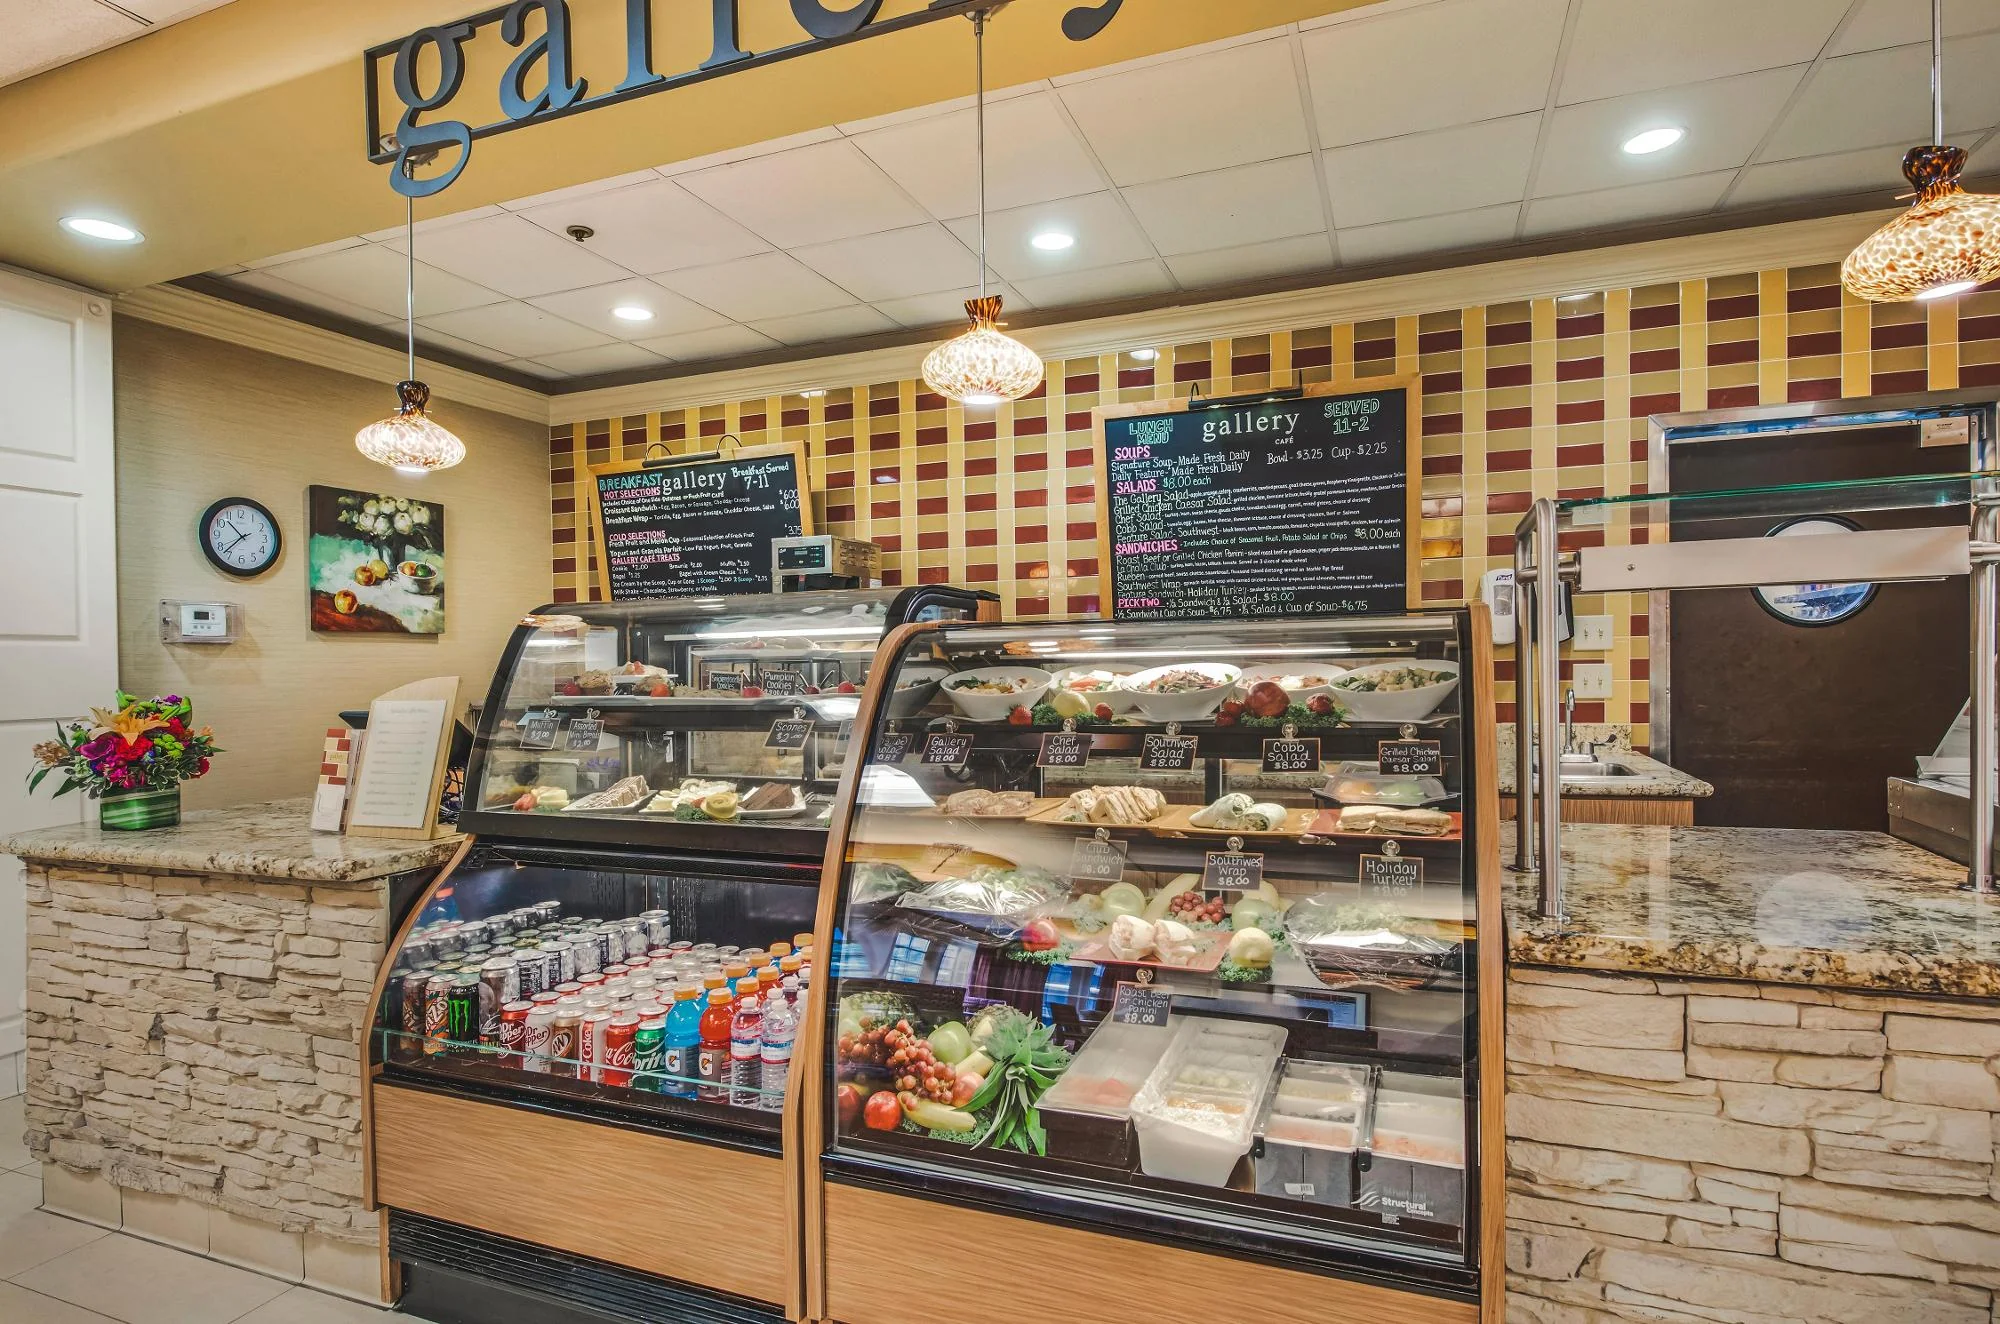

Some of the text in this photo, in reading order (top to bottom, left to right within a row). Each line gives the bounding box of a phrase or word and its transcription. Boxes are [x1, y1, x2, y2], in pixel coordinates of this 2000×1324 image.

[1324, 398, 1380, 418] SERVED
[1129, 418, 1174, 435] LUNCH
[1202, 411, 1300, 443] gallery
[1333, 416, 1370, 435] 11-2
[1137, 431, 1169, 446] MENU
[1275, 436, 1294, 445] CAFÉ
[1111, 441, 1388, 473] Signature Fresh Daily $3.25 $2.25
[1114, 445, 1151, 461] SOUPS
[731, 462, 789, 477] Breakfast Served
[1112, 461, 1244, 482] Daily Made Fresh Daily
[599, 473, 663, 491] BREAKFAST
[662, 470, 726, 495] gallery
[743, 473, 769, 490] 7-11
[1163, 475, 1212, 489] $8.00 each
[604, 487, 661, 500] HOT SELECTIONS
[1113, 492, 1163, 508] The Gallery
[603, 504, 658, 515] Croissant Sandwich
[1113, 503, 1139, 517] Grilled
[1142, 499, 1173, 513] Chicken
[1174, 498, 1205, 510] Caesar
[225, 511, 232, 521] 11
[237, 509, 245, 519] 12
[605, 516, 633, 524] Breakfast
[1115, 513, 1136, 525] Chef
[216, 518, 226, 529] 10
[258, 522, 265, 533] 2
[213, 529, 221, 540] 9
[610, 529, 667, 543] COLD SELECTIONS
[1115, 524, 1138, 536] Cobb
[262, 534, 268, 544] 3
[1115, 540, 1178, 556] SANDWICHES
[1211, 538, 1229, 547] Choice
[1230, 536, 1237, 545] of
[1303, 531, 1320, 542] Salad
[1354, 527, 1384, 541] $8.00
[1386, 525, 1401, 539] each
[217, 542, 224, 552] 8
[258, 545, 265, 555] 4
[238, 555, 246, 564] 6
[250, 552, 257, 563] 5
[611, 552, 681, 566] GALLERY CAFÉ TREATS
[1142, 553, 1161, 564] Beef
[1198, 547, 1224, 560] Chicken
[1117, 581, 1159, 592] Southwest
[1188, 585, 1219, 599] Holiday
[1177, 592, 1295, 608] Sandwich $8.00
[1127, 604, 1159, 618] Sandwich
[1178, 606, 1187, 616] of
[1250, 600, 1276, 614] Salad
[1286, 601, 1302, 614] Cup
[1304, 599, 1315, 613] of
[1342, 598, 1369, 610] $6.75
[765, 671, 795, 682] Pumpkin
[766, 680, 793, 690] Cookies
[530, 720, 555, 730] Muffin
[573, 721, 598, 732] Assorted
[776, 721, 809, 733] Scones
[530, 730, 551, 742] $2.00
[776, 732, 804, 744] $2.00
[930, 736, 968, 748] Gallery
[1052, 735, 1077, 746] Chef
[1146, 736, 1196, 750] Southwest
[1272, 742, 1306, 754] Cobb
[928, 745, 960, 756] Salad
[1047, 744, 1081, 755] Salad
[1150, 748, 1185, 760] Salad
[1380, 746, 1440, 757] Grilled Chicken
[929, 754, 955, 763] $8.00
[1048, 754, 1078, 764] $8.00
[1267, 751, 1312, 762] Salad
[1381, 755, 1437, 764] Caesar Salad
[1149, 758, 1180, 768] $8.00
[1273, 761, 1308, 770] $8.00
[1393, 763, 1429, 773] $8.00
[1218, 866, 1246, 877] Wrap
[1366, 860, 1417, 880] Holiday
[1217, 876, 1250, 887] $8.00
[1371, 873, 1412, 888] Turkey
[1120, 985, 1147, 998] Roast
[1133, 998, 1168, 1008] Chicken
[1129, 1005, 1157, 1015] Panini
[1124, 1013, 1155, 1024] $8.00
[502, 1022, 516, 1036] Dr
[527, 1026, 540, 1038] Dr
[582, 1029, 593, 1059] Coke
[665, 1050, 681, 1073] G
[699, 1053, 713, 1076] G
[1381, 1196, 1427, 1211] Structural
[1406, 1208, 1434, 1217] Concepts
